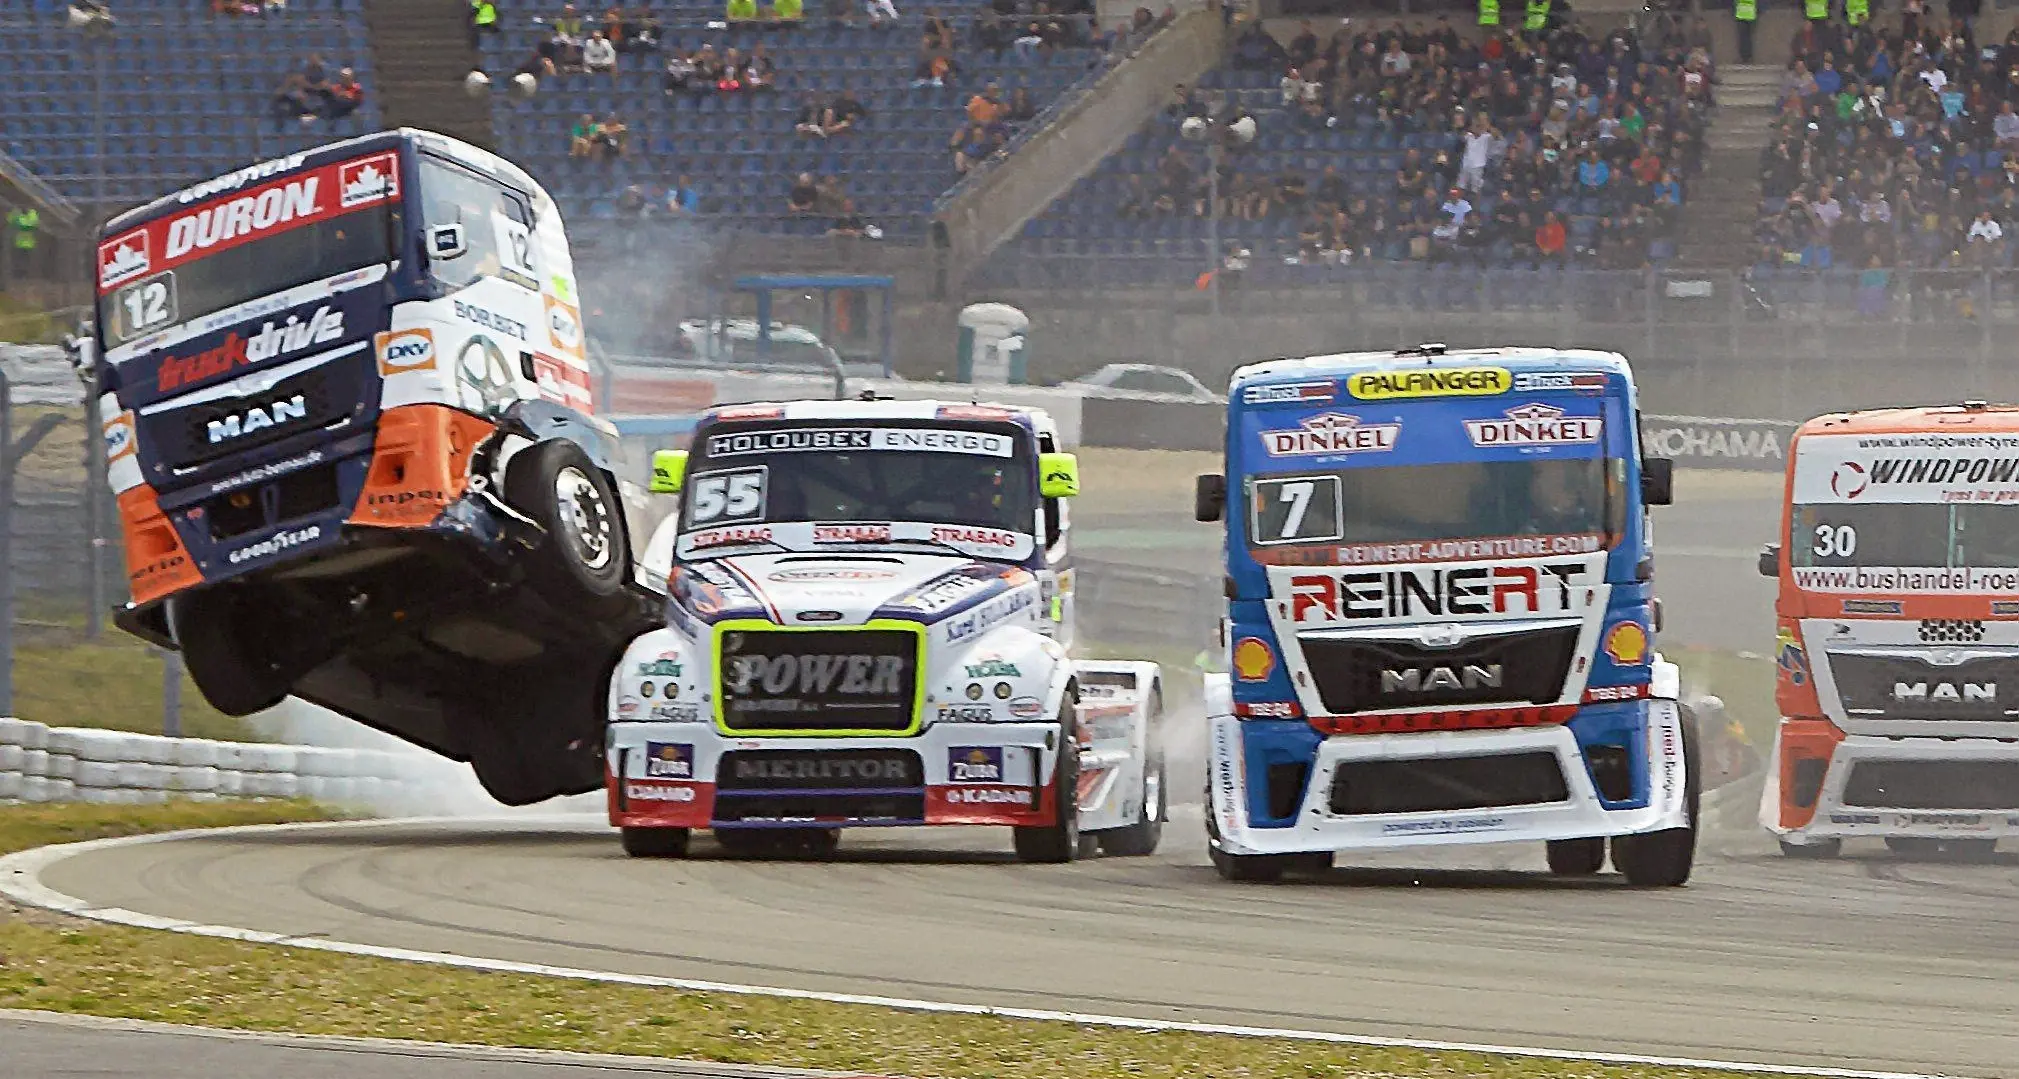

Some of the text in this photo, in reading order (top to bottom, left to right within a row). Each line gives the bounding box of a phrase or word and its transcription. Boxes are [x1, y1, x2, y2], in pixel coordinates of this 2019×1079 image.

[166, 177, 320, 259] DURON
[124, 282, 168, 329] 12
[386, 342, 430, 361] DKV
[1358, 370, 1500, 394] PALFINGER
[207, 394, 306, 443] MAN
[1480, 418, 1594, 443] DINKEL
[712, 430, 1000, 454] HOLOUBEK ENERGO
[1276, 428, 1390, 453] DINKEL
[1870, 458, 2019, 484] WINDPOW
[694, 473, 761, 521] 55
[1278, 481, 1315, 539] 7
[692, 527, 773, 549] STRABAG
[813, 526, 891, 543] STRABAG
[931, 526, 1016, 548] STRABAG
[1812, 525, 1857, 558] 30
[1337, 535, 1600, 563] REINERT-ADVENTURE.COM
[1796, 566, 2019, 590] www.bushandel-roe
[1290, 563, 1586, 622] REINERT
[731, 654, 904, 694] POWER
[1381, 663, 1503, 693] MAN
[1894, 682, 1997, 703] MAN
[736, 759, 906, 778] MERITOR
